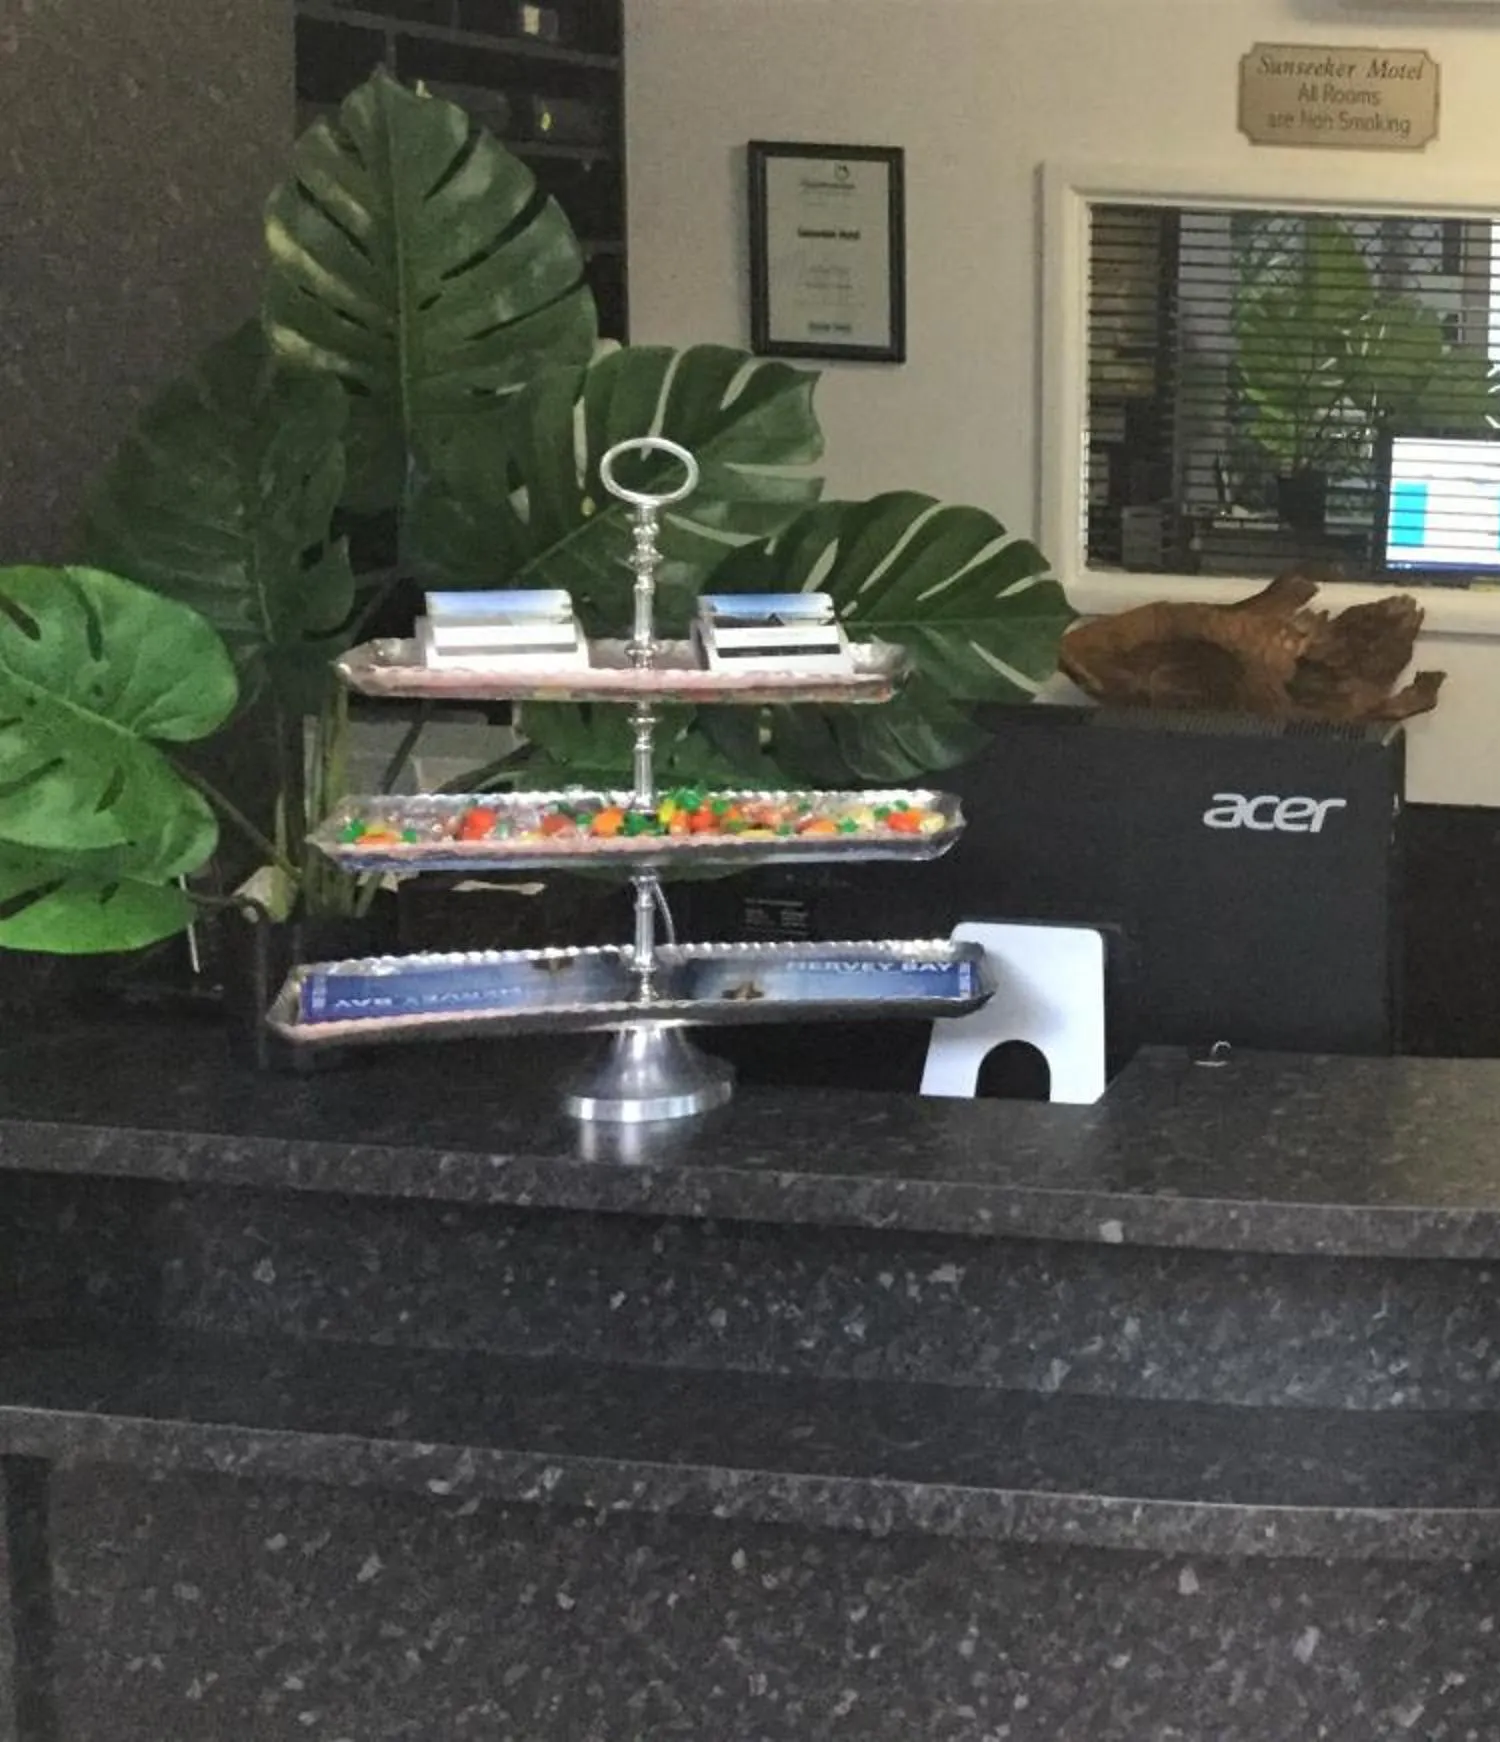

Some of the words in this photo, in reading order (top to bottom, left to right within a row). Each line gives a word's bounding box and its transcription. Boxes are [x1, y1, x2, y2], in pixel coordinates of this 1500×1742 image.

[1367, 59, 1424, 81] Motel
[1298, 82, 1318, 102] All
[1322, 83, 1382, 106] Rooms
[1268, 112, 1295, 129] are
[1338, 110, 1412, 137] Smoking
[1203, 793, 1348, 833] acer
